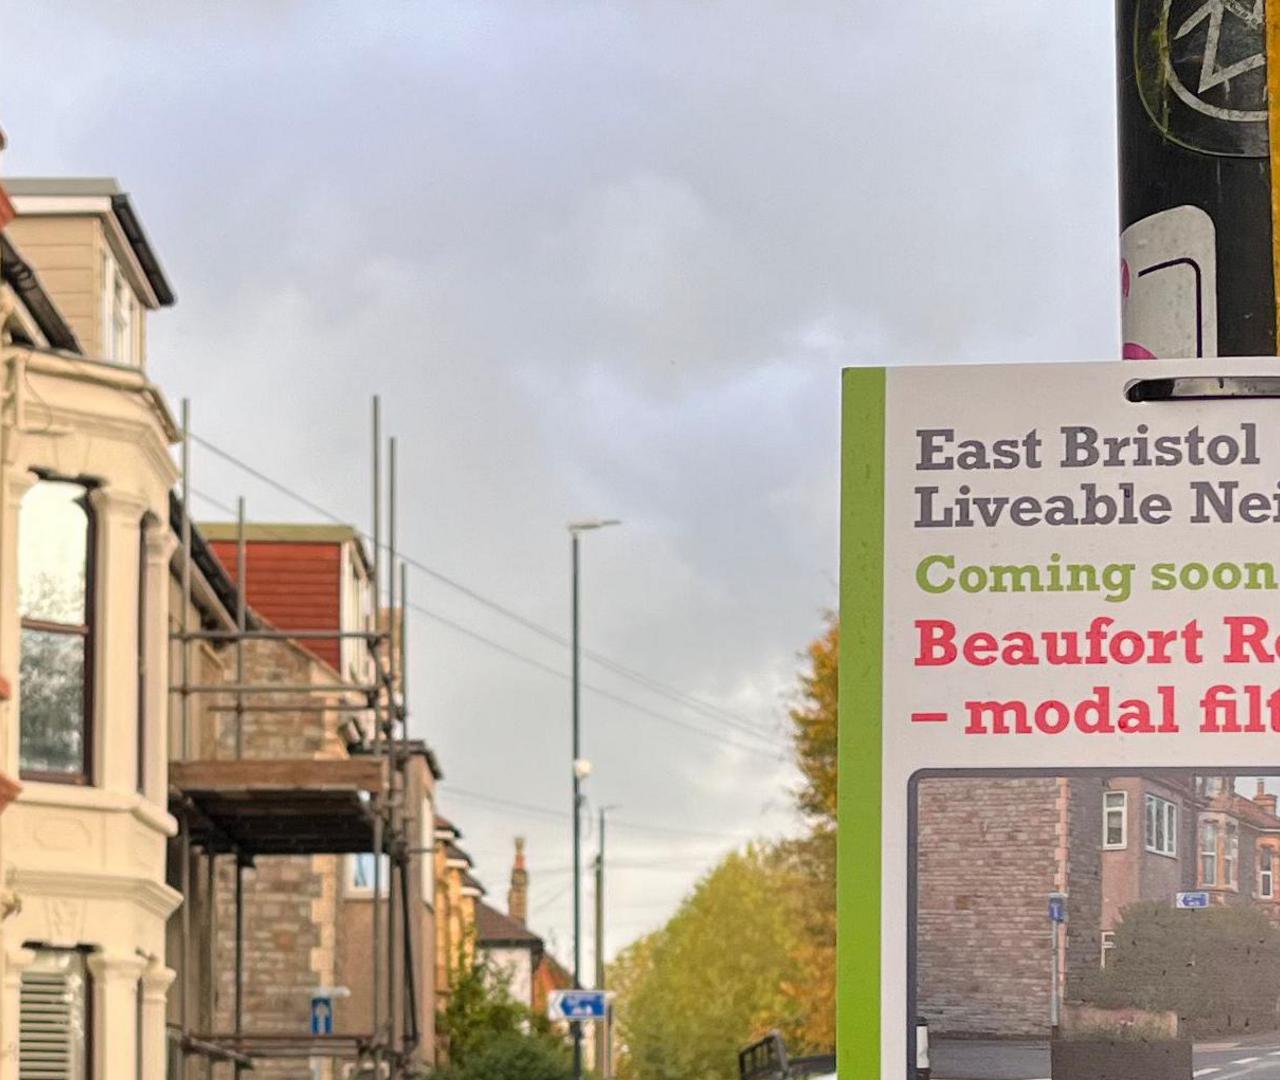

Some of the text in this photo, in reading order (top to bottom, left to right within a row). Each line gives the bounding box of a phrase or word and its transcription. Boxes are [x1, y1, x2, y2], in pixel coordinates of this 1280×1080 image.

[915, 422, 1261, 471] East Bristol
[913, 482, 1173, 529] Liveable
[915, 552, 1279, 603] Coming soon
[913, 616, 1204, 667] Beaufort
[964, 685, 1180, 735] modal
